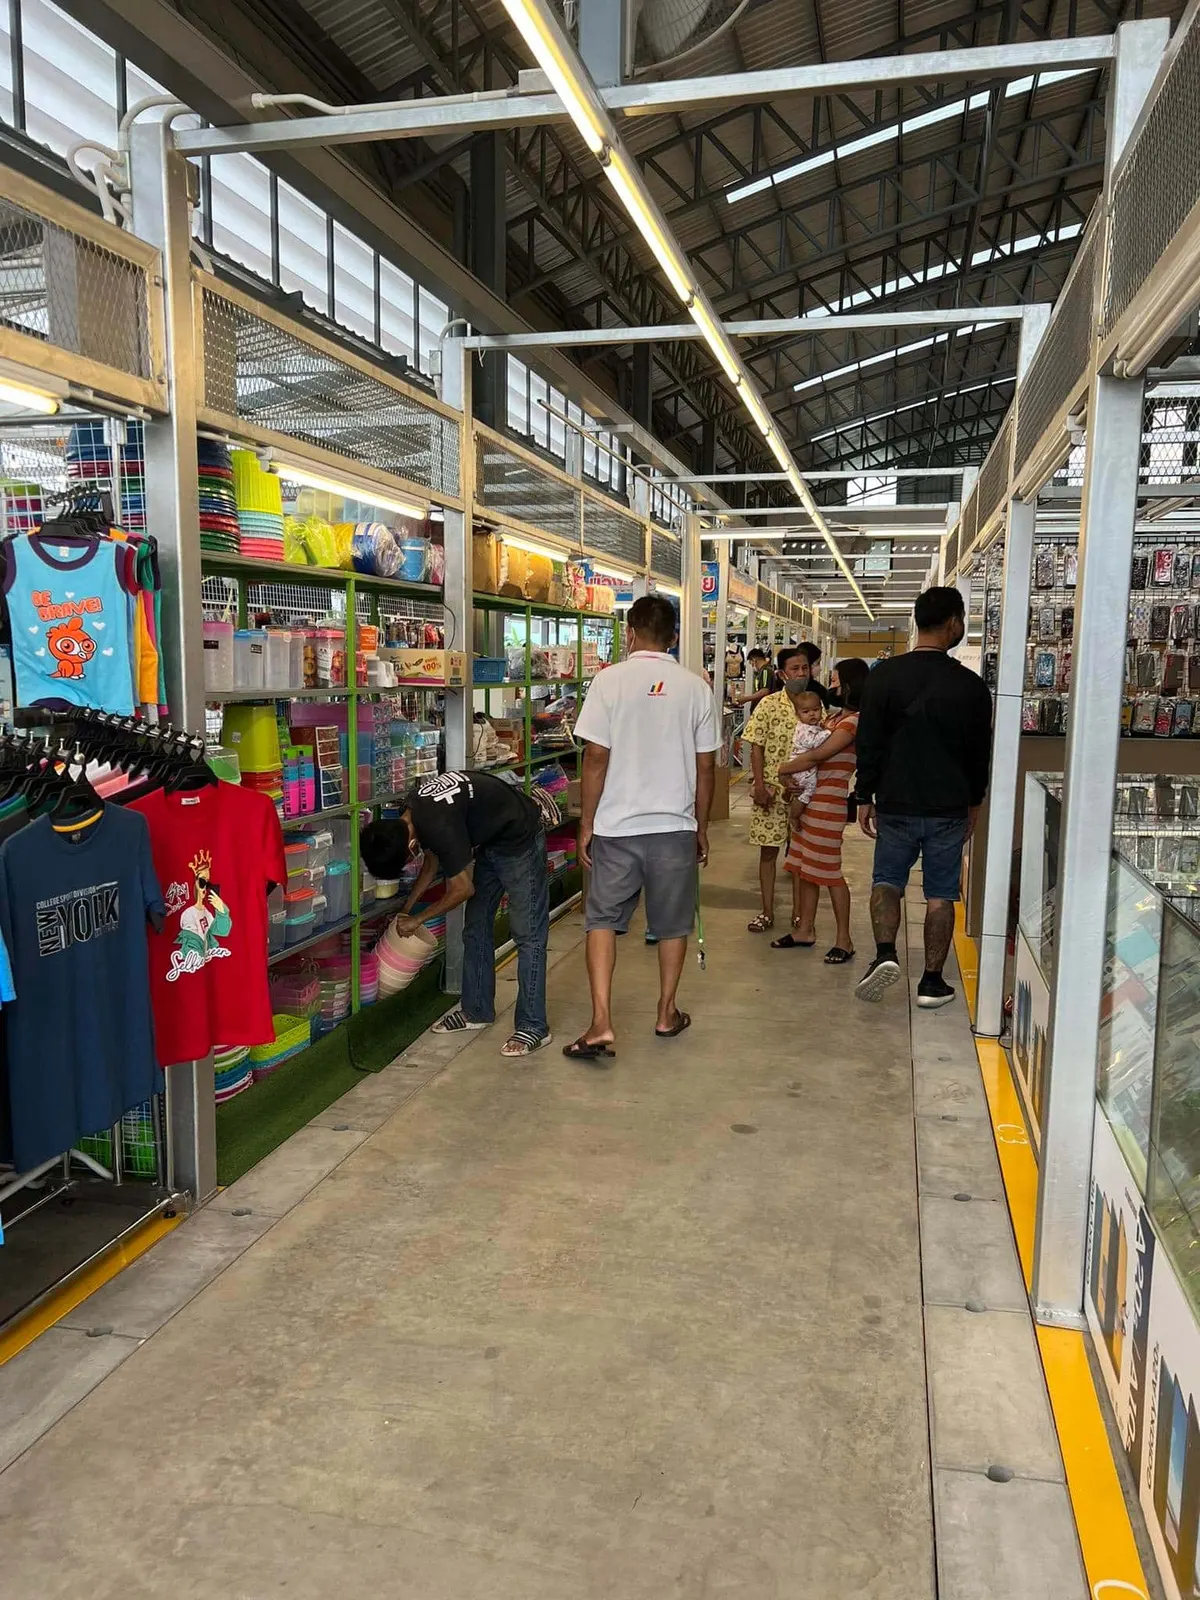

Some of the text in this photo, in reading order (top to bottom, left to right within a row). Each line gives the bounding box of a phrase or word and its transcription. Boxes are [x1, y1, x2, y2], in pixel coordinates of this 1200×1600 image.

[31, 590, 52, 607] BE
[37, 596, 104, 622] BRAVE!
[36, 896, 61, 910] COLLEGE
[36, 887, 120, 957] NEW YORK
[1146, 1396, 1156, 1490] Galaxy
